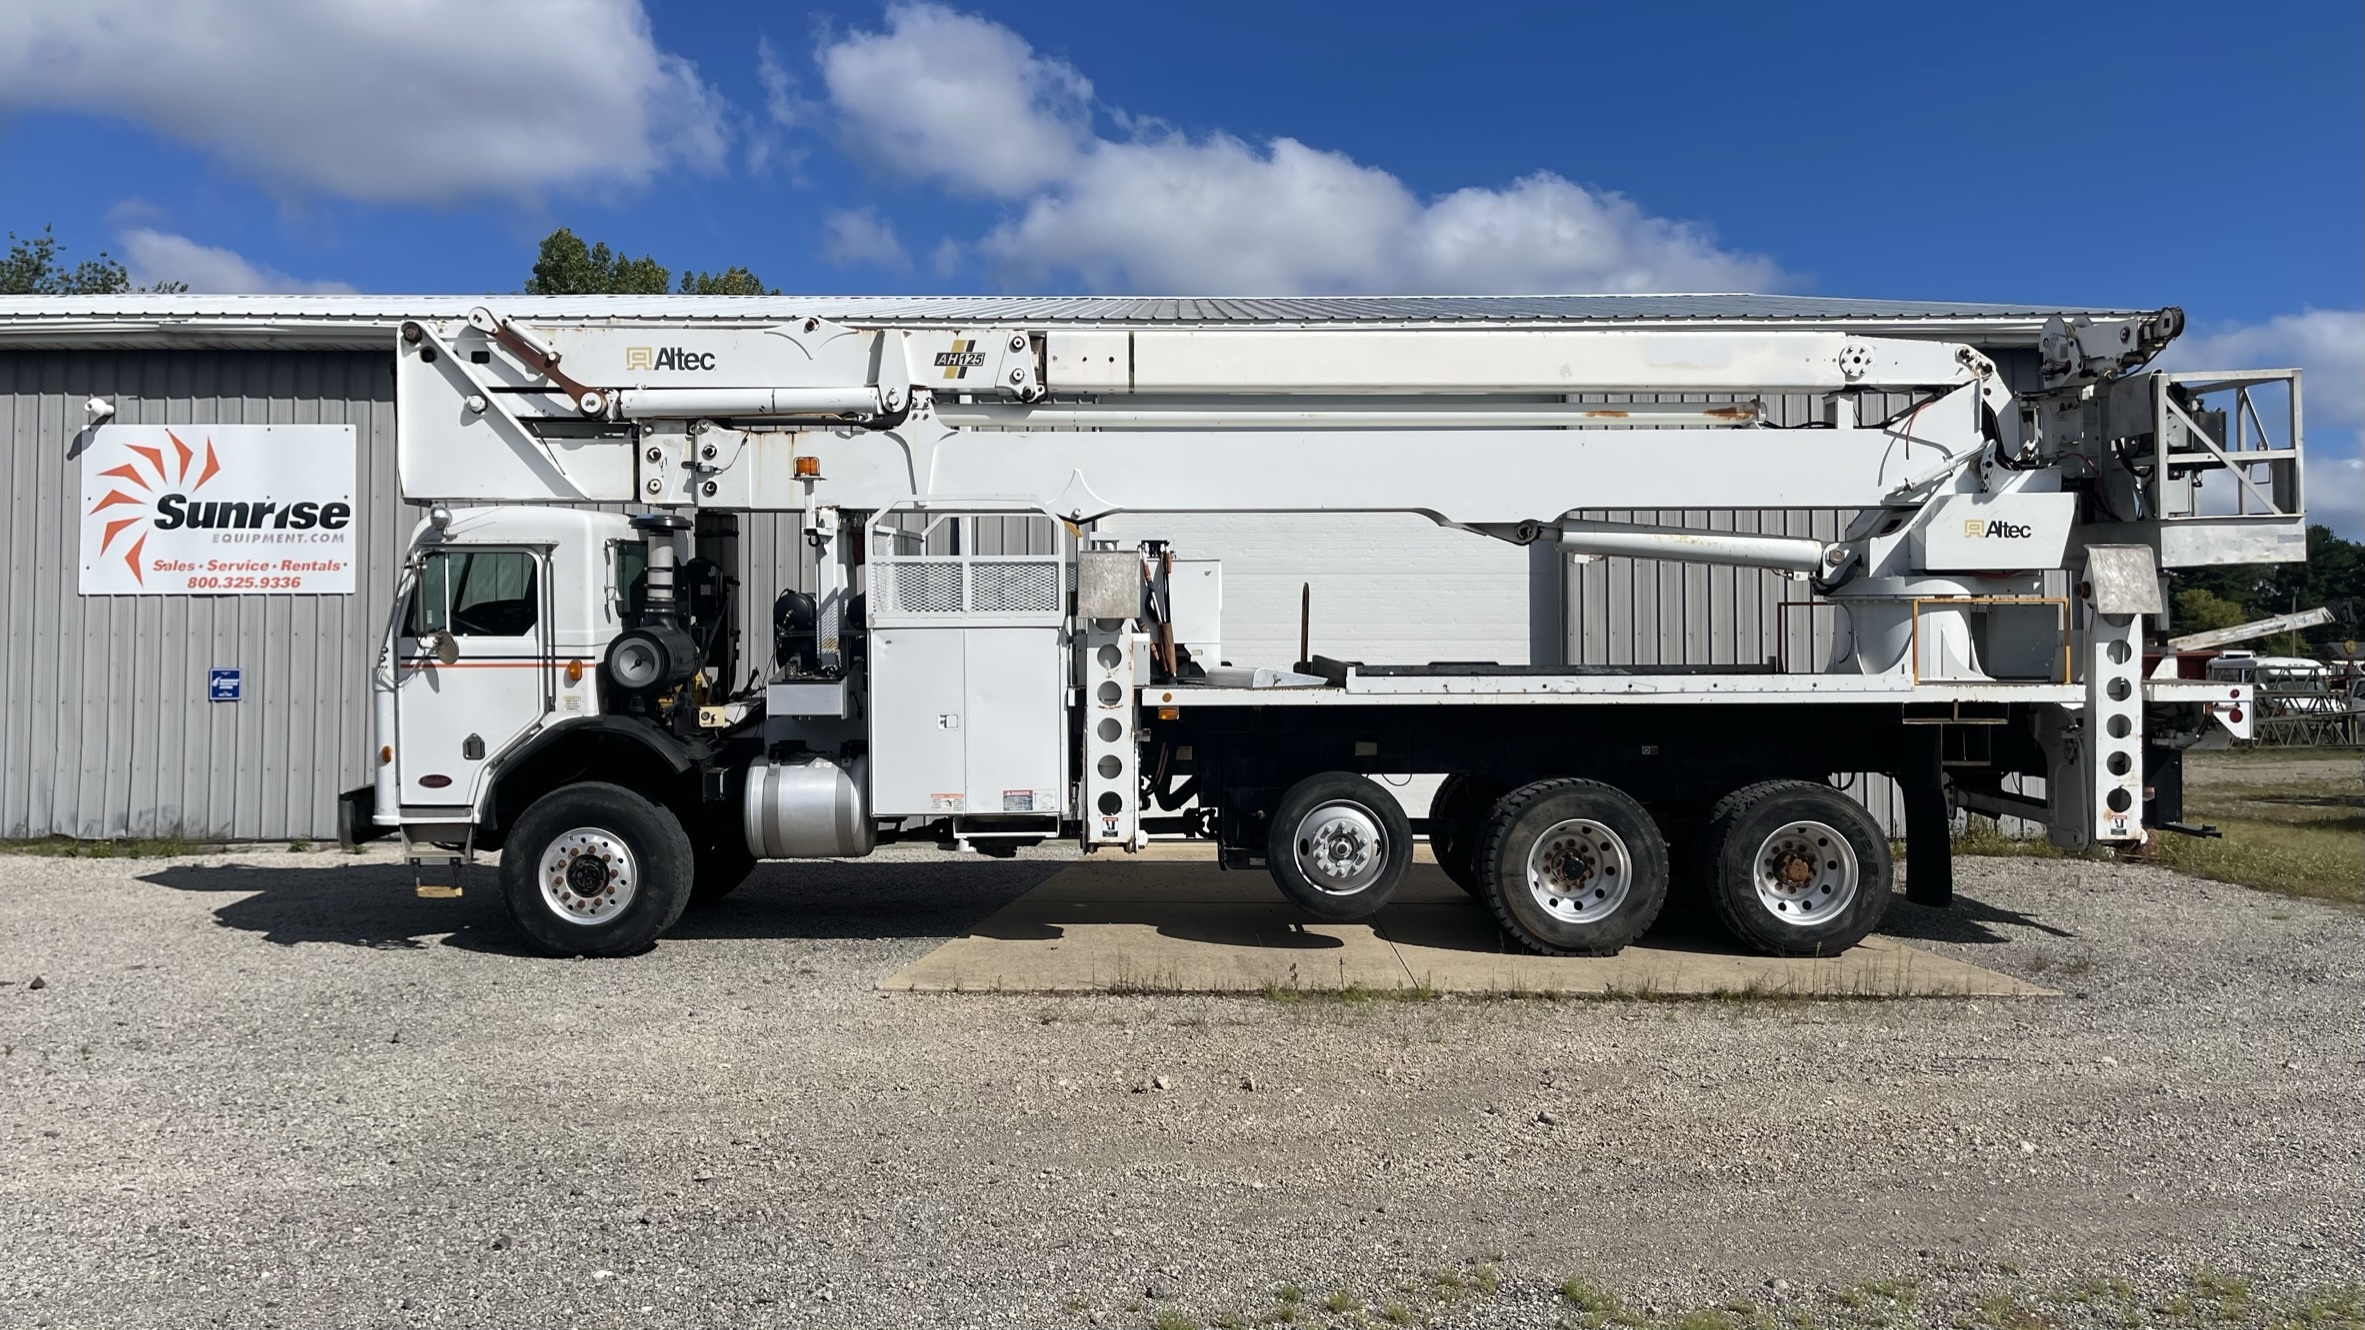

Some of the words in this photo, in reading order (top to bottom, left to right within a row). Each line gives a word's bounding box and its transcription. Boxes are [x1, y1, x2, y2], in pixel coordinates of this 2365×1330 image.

[654, 347, 715, 371] Altec
[153, 493, 351, 530] Sunrise
[1985, 520, 2031, 539] Altec
[212, 533, 345, 544] EQUIPMENT.COM
[153, 560, 195, 572] Sales
[207, 559, 269, 572] Service
[280, 559, 341, 572] Rentals
[187, 577, 301, 589] 800.325.9336
